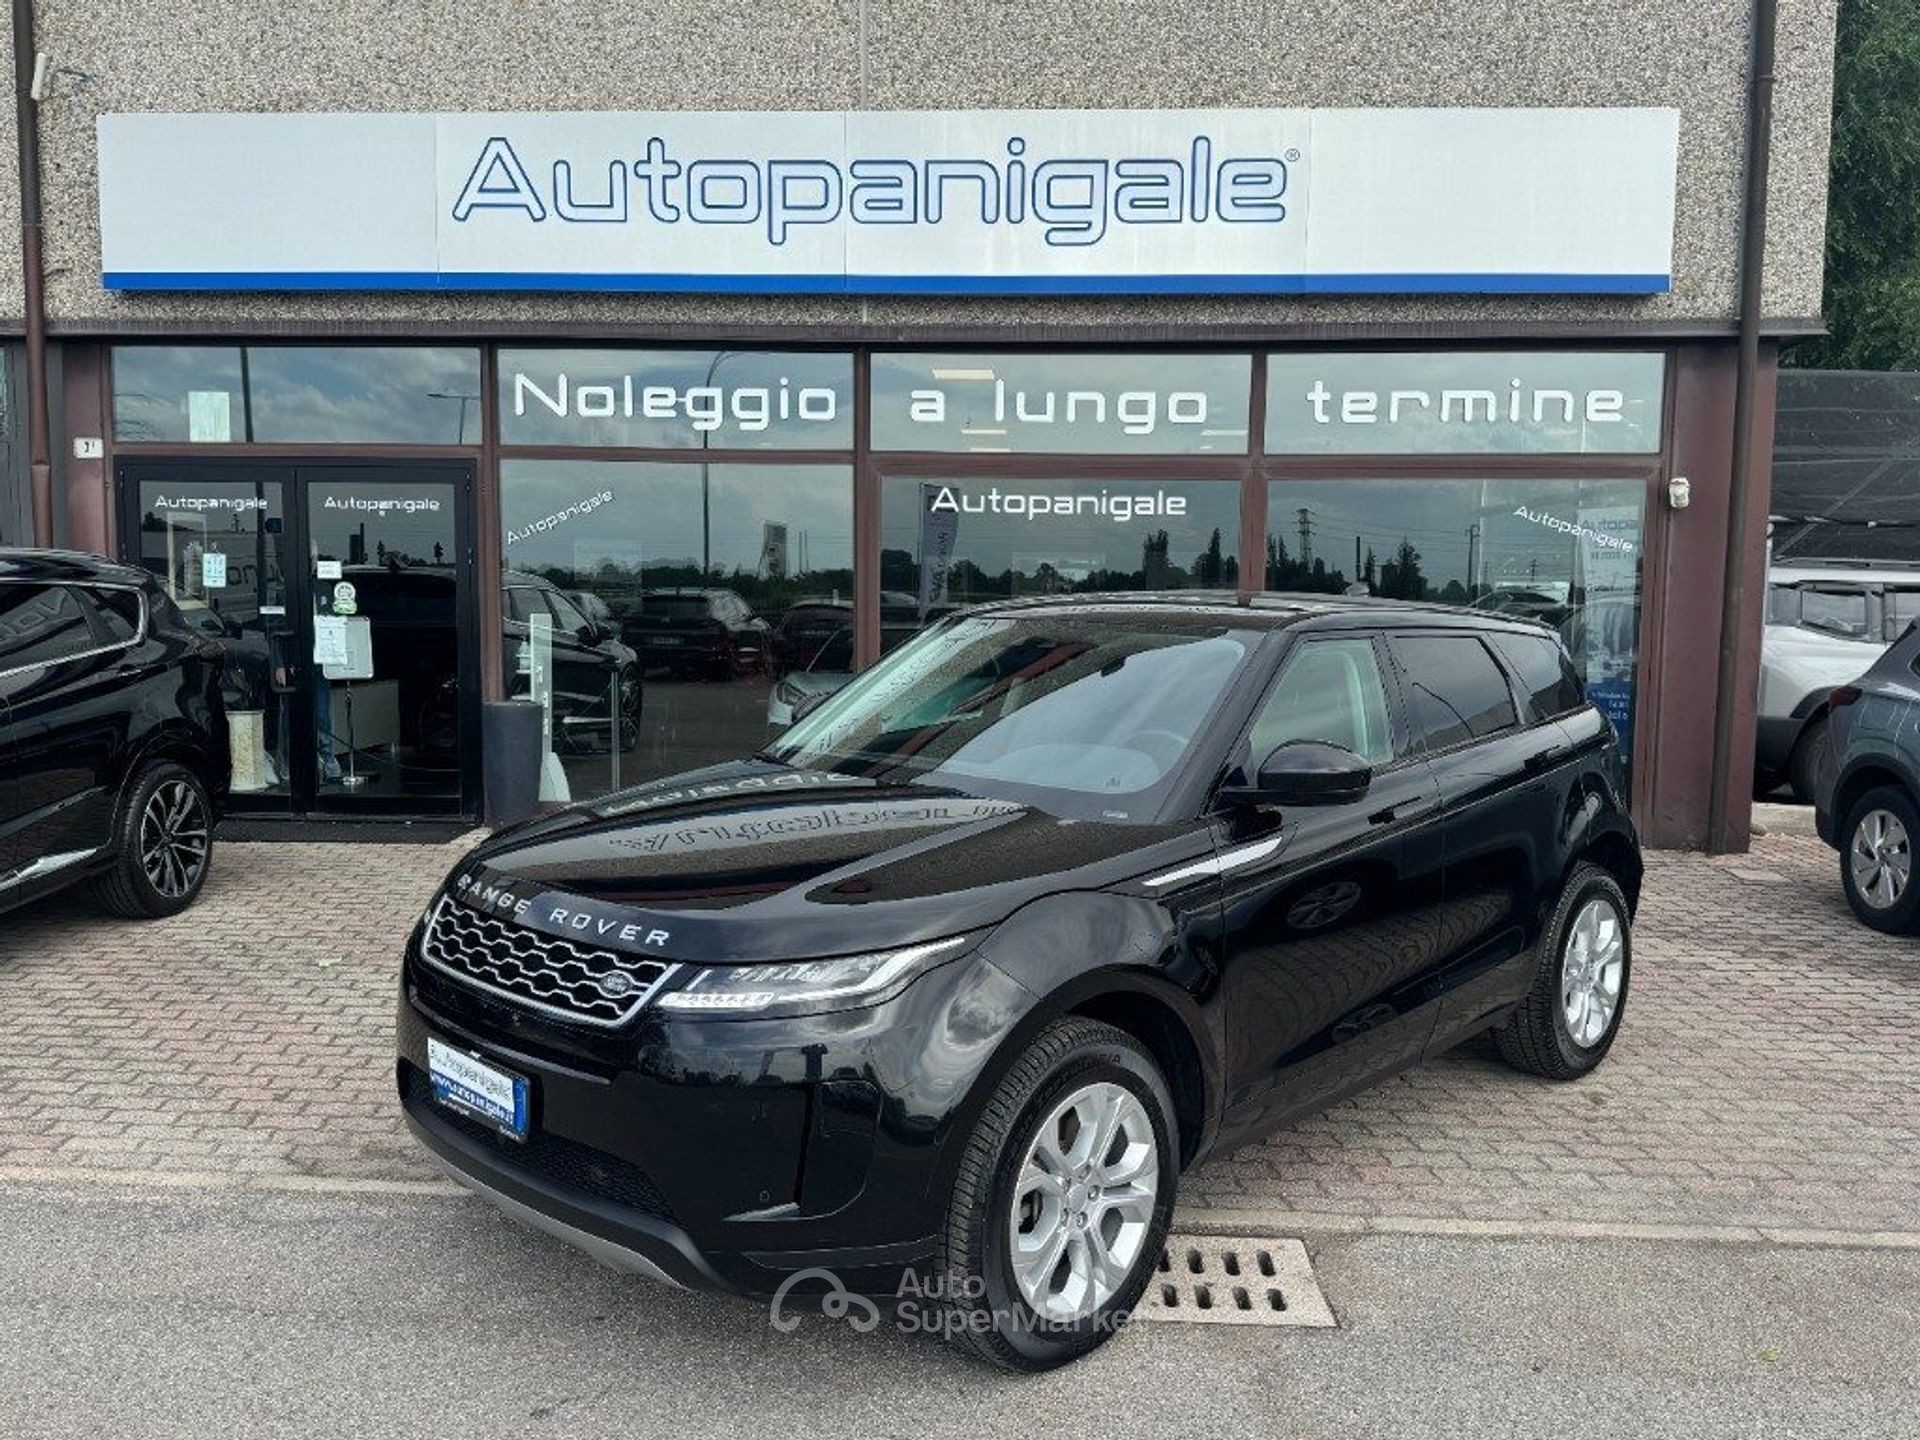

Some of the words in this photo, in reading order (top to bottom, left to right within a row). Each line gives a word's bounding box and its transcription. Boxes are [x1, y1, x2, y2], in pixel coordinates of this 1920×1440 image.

[513, 372, 836, 431] Noleggio
[909, 388, 945, 423] a
[995, 379, 1207, 435] lungo
[1307, 377, 1625, 424] termine
[154, 495, 268, 512] Autopanigale
[324, 496, 440, 513] Autopanigale
[507, 489, 613, 545] Autopanigale
[931, 487, 1187, 522] Autopanigale
[1513, 505, 1633, 553] Autopanigale
[457, 873, 532, 915] RANGE
[549, 907, 670, 946] ROVER
